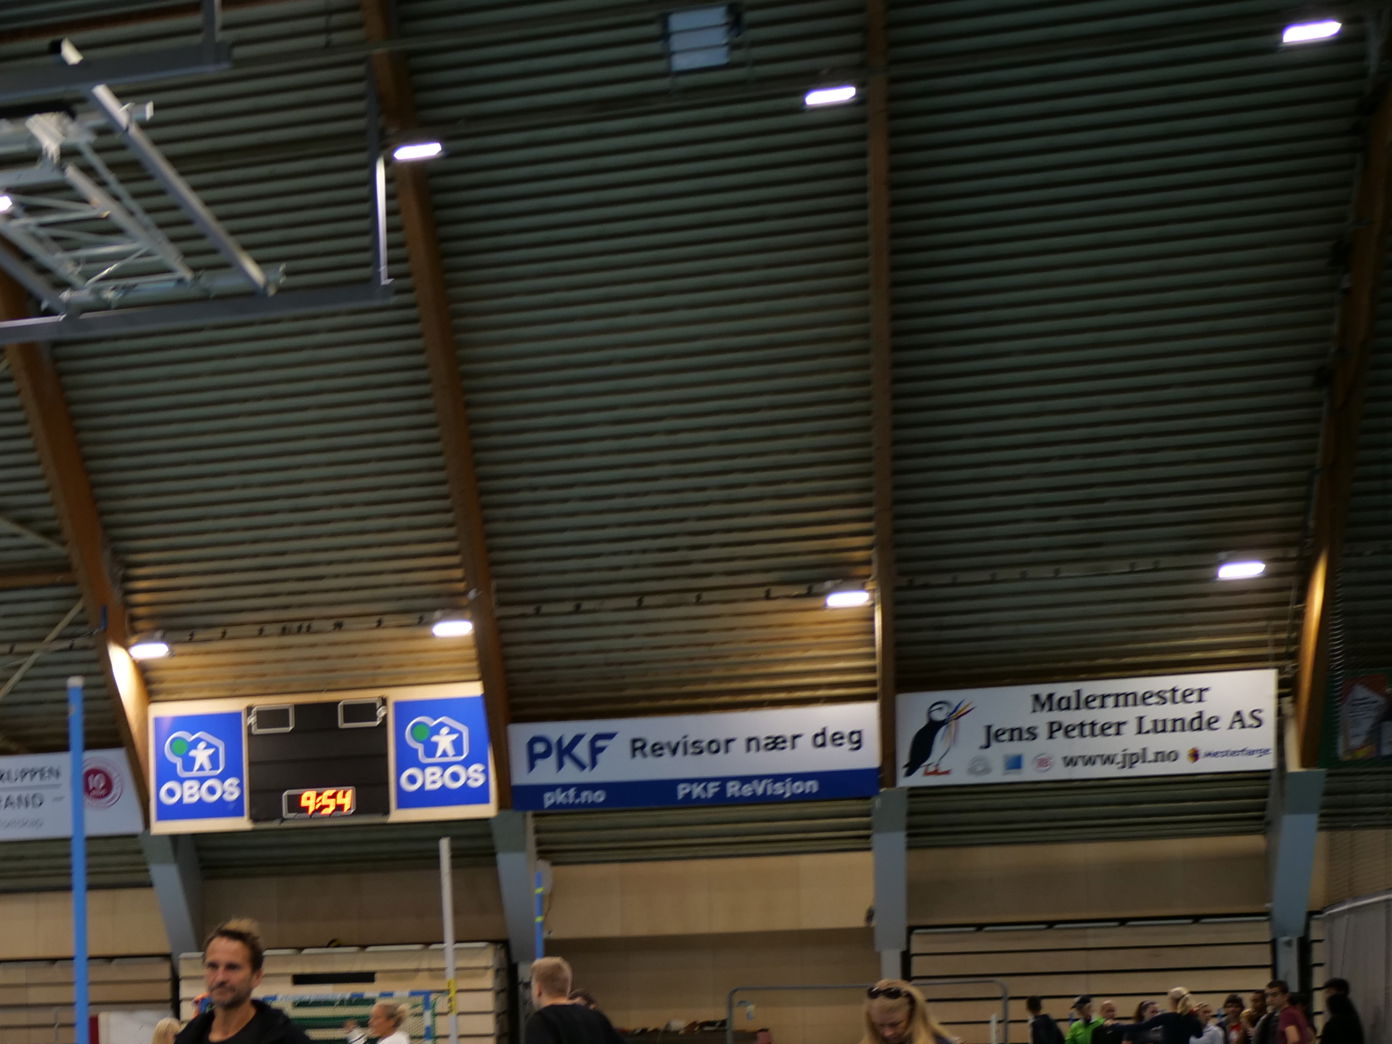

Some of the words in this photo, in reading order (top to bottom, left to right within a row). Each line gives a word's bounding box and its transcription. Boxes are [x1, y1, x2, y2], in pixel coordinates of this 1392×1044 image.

[1030, 685, 1210, 714] Malermester
[629, 734, 737, 759] Revisor
[745, 731, 803, 754] nær
[811, 726, 864, 751] deg
[980, 723, 1038, 749] Jens
[1046, 716, 1128, 740] Petter
[1135, 710, 1220, 736] Lunde
[1228, 708, 1264, 730] AS
[525, 731, 619, 774] PKF
[1062, 747, 1179, 769] www.jpl.no
[159, 777, 242, 806] OBOS
[399, 763, 486, 793] OBOS
[676, 781, 722, 801] PKF
[300, 789, 353, 815] 9:54
[543, 787, 607, 808] pkf.no
